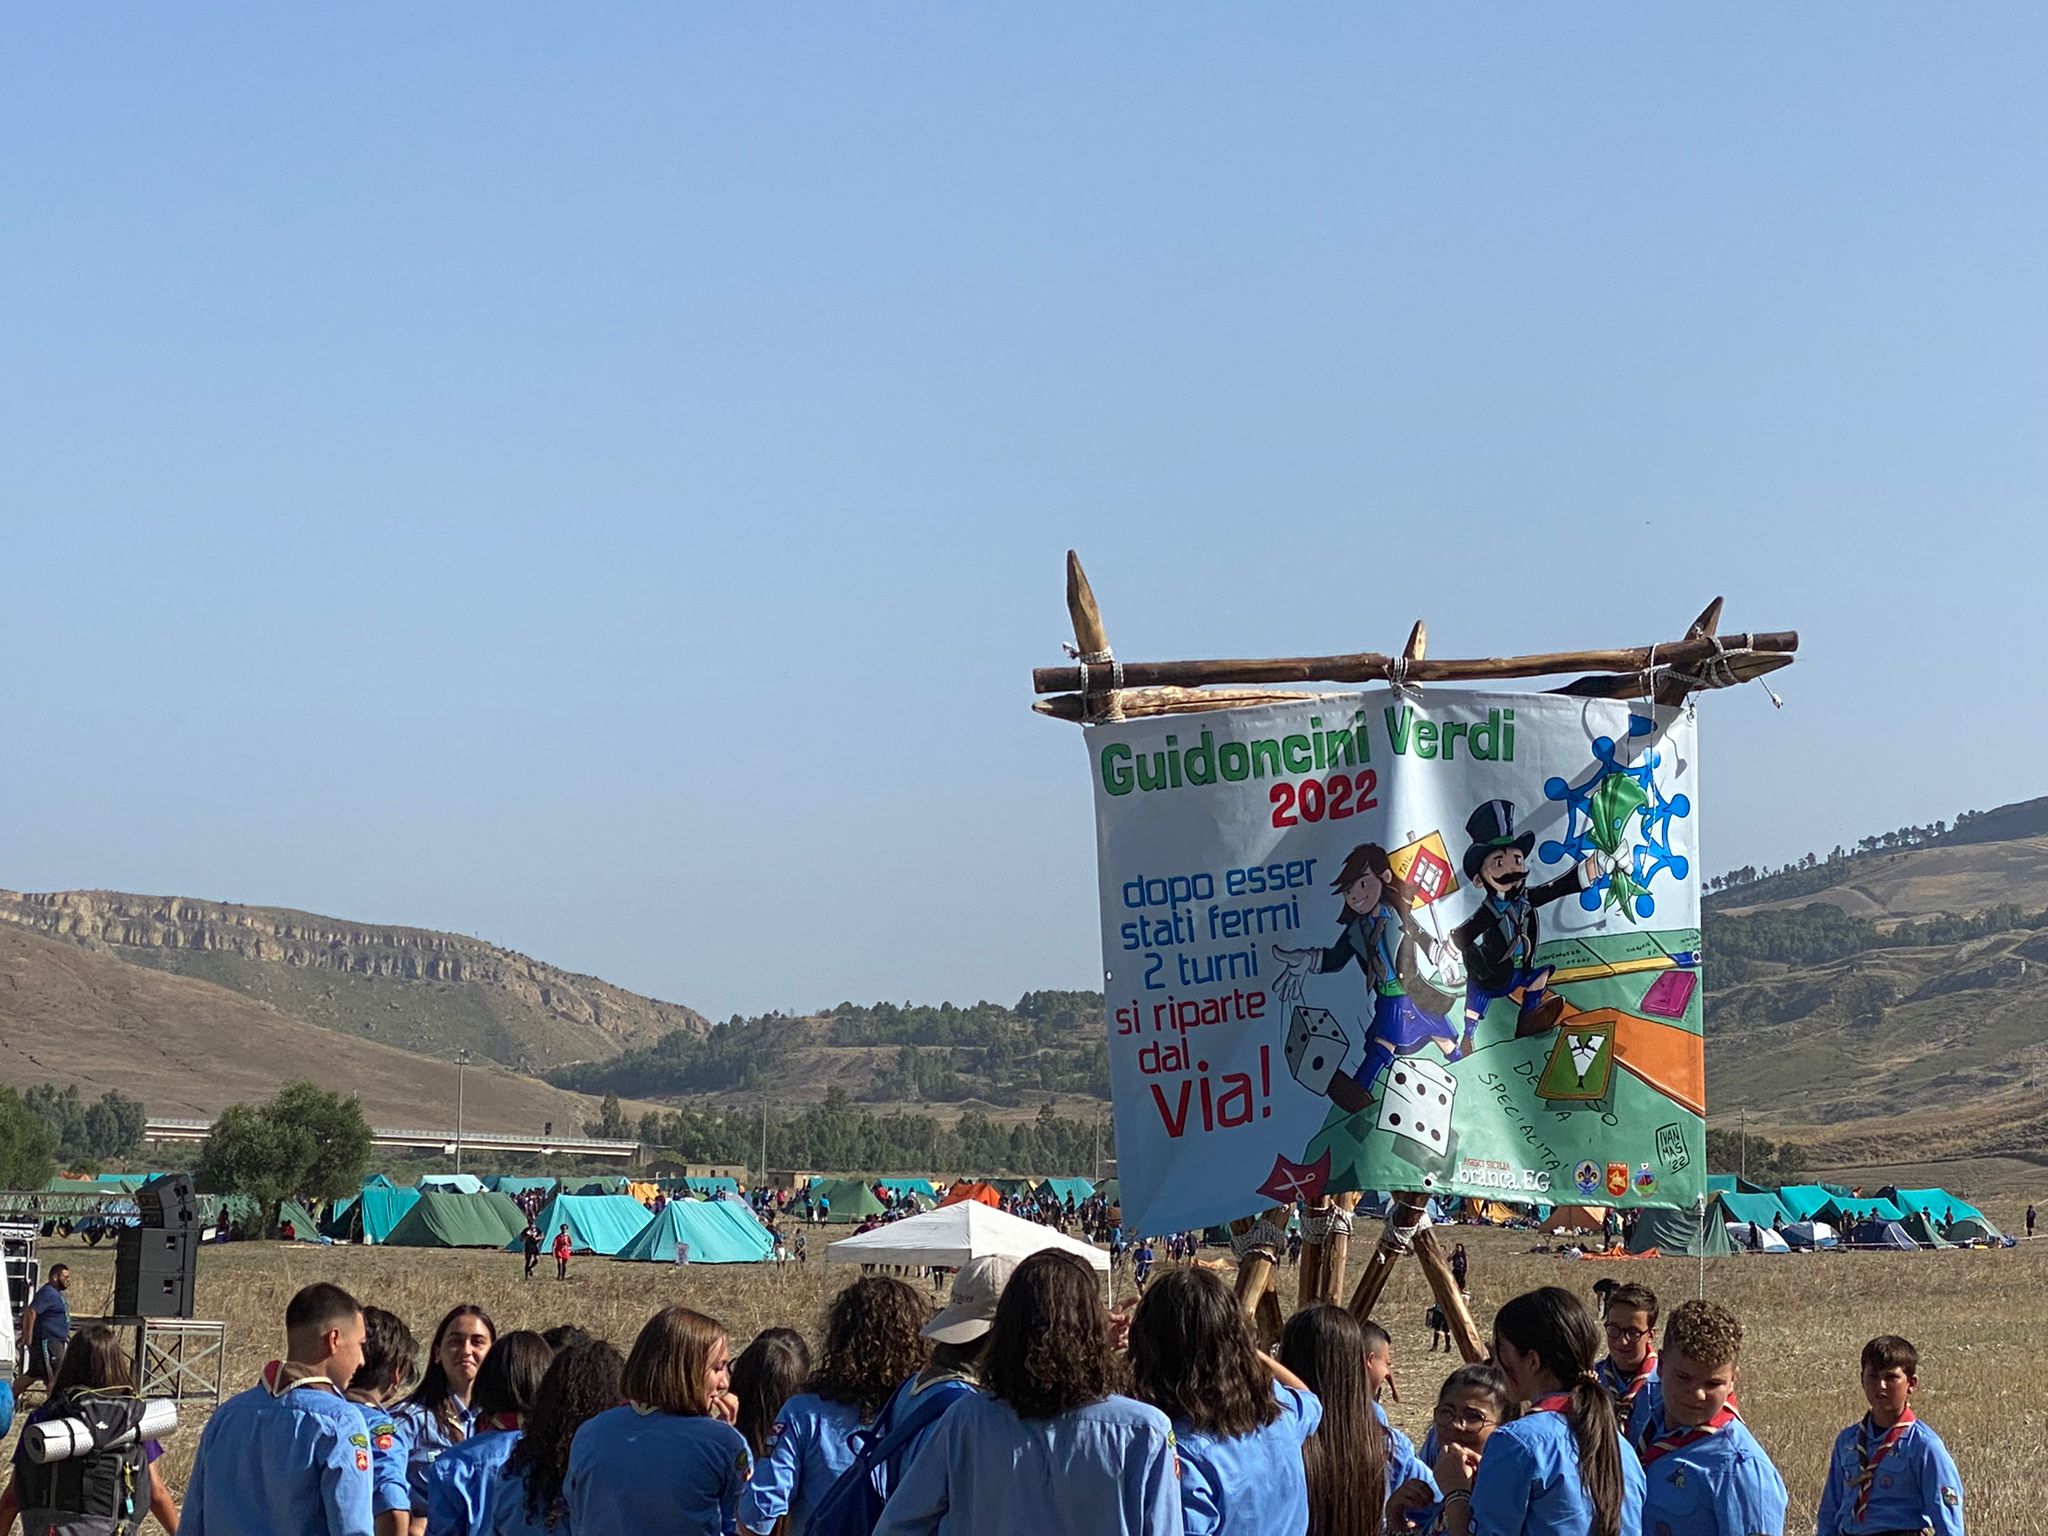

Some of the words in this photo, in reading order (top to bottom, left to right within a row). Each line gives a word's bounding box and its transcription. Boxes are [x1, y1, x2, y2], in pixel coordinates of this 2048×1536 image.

[1100, 710, 1371, 797] Guidoncini
[1384, 705, 1515, 762] Verdi
[1269, 769, 1378, 828] 2022
[1123, 874, 1215, 910] dopo
[1226, 858, 1317, 895] esser
[1121, 909, 1195, 950] stati
[1208, 895, 1301, 940] fermi
[1144, 953, 1166, 990] 2
[1178, 943, 1259, 987] turni
[1115, 999, 1141, 1036] si
[1153, 988, 1267, 1036] riparte
[1138, 1037, 1191, 1074] dal
[1660, 1126, 1680, 1147] IVAN
[1662, 1142, 1683, 1160] MAS
[1458, 1162, 1520, 1190] branca
[1522, 1168, 1551, 1193] EG
